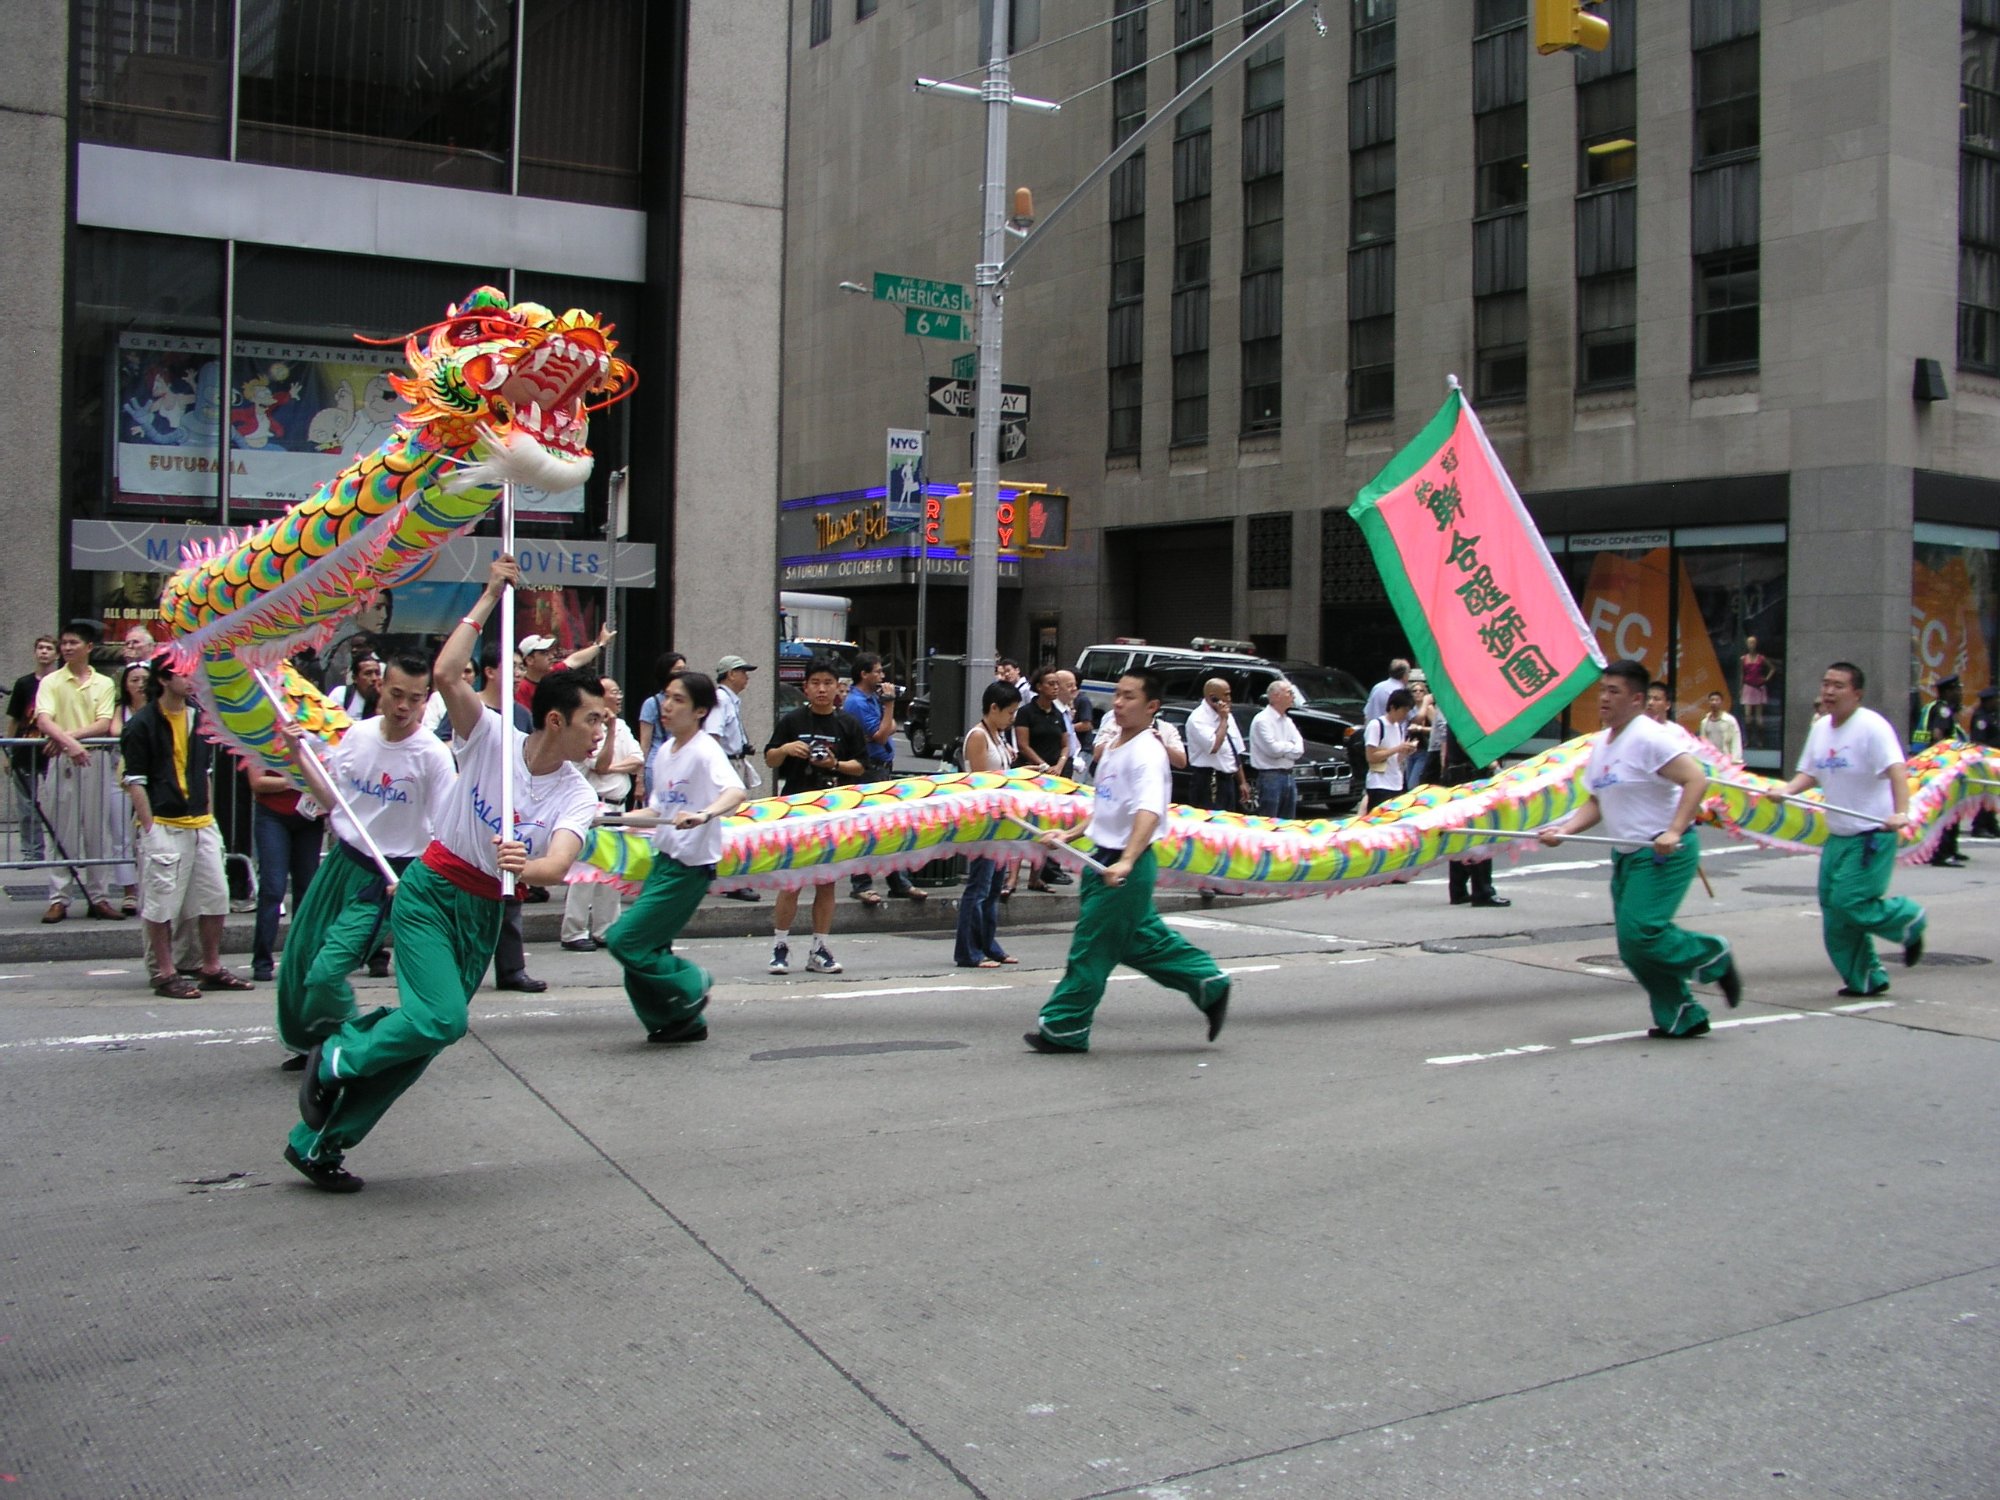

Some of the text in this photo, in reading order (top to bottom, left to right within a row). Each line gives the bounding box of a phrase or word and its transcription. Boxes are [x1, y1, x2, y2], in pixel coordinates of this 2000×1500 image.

[886, 285, 960, 310] AMERICAS
[917, 313, 950, 334] 6 AV
[130, 337, 411, 365] GREAT NTERTAINMENT
[943, 390, 1019, 410] ONE AY
[890, 437, 919, 450] NYC
[815, 509, 860, 550] Music
[785, 564, 830, 580] SATURDAY
[838, 559, 882, 576] OCTOBER
[103, 607, 120, 619] ALL
[123, 607, 138, 619] OR
[1590, 596, 1652, 663] FC
